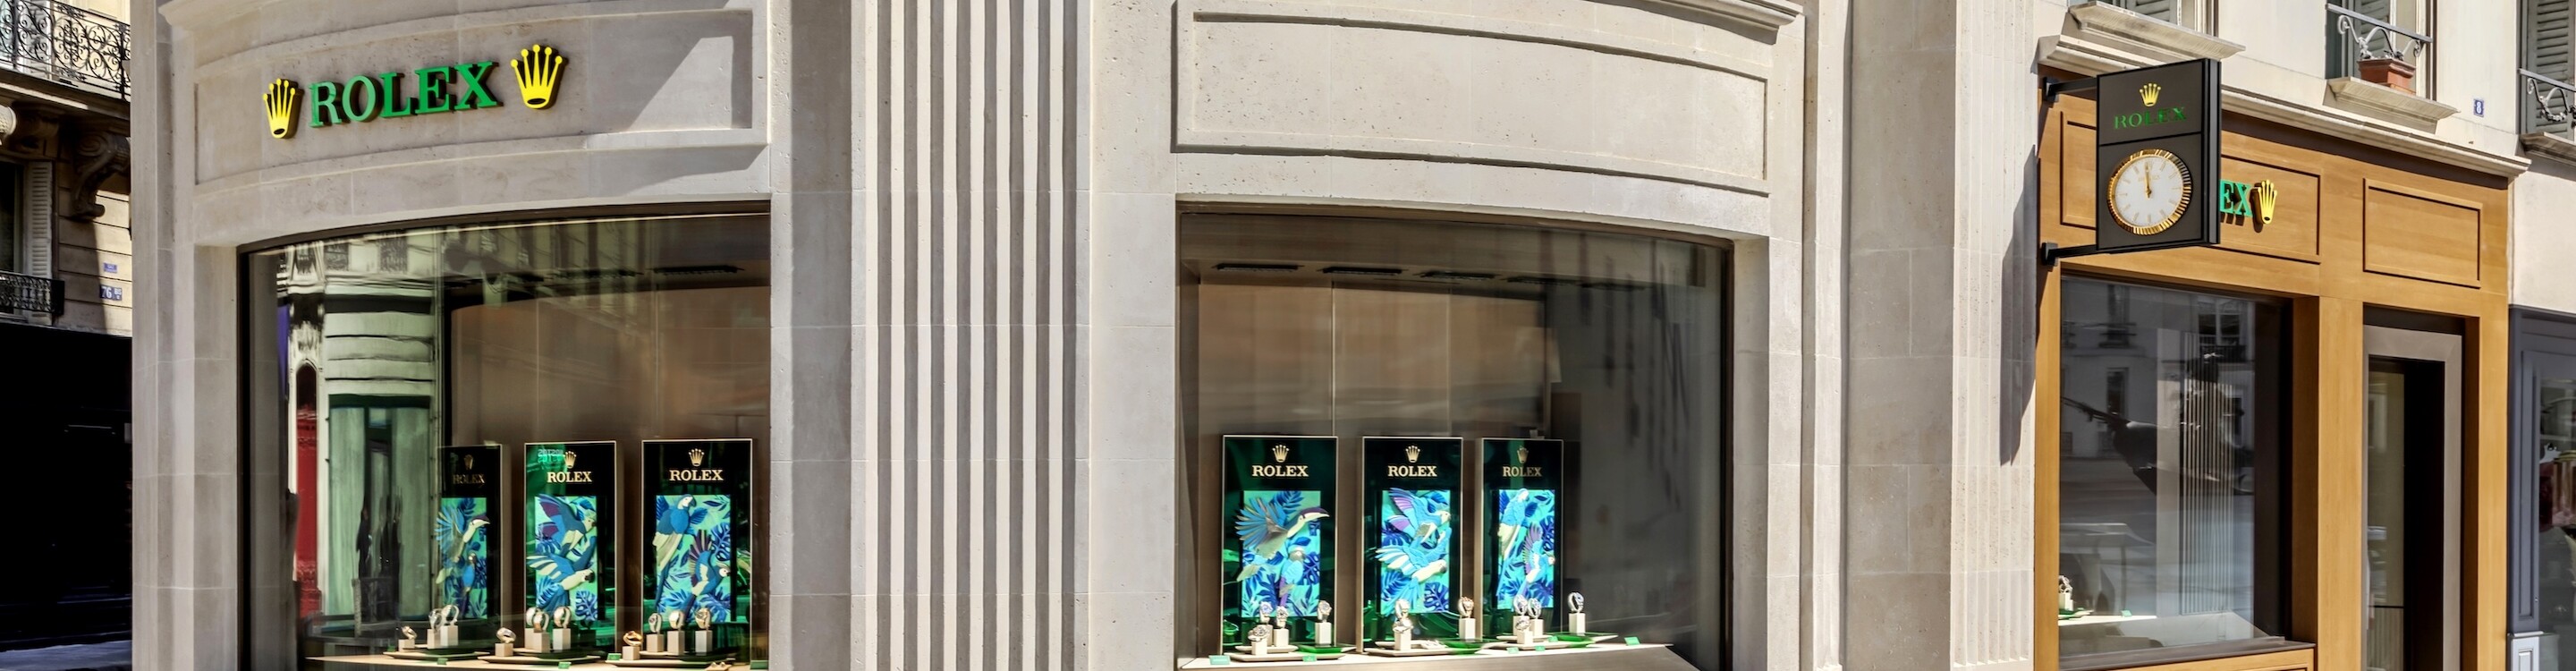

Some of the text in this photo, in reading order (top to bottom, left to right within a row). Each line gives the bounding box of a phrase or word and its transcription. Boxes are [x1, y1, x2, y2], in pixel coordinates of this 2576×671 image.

[309, 62, 497, 127] ROLEX
[2477, 101, 2482, 114] 8
[2114, 107, 2186, 129] ROLEX
[101, 286, 112, 299] 76
[547, 471, 592, 482] ROLEX
[669, 470, 724, 481] ROLEX
[1252, 465, 1309, 477] ROLEX
[1387, 465, 1437, 477] ROLEX
[1503, 466, 1542, 477] ROLEX
